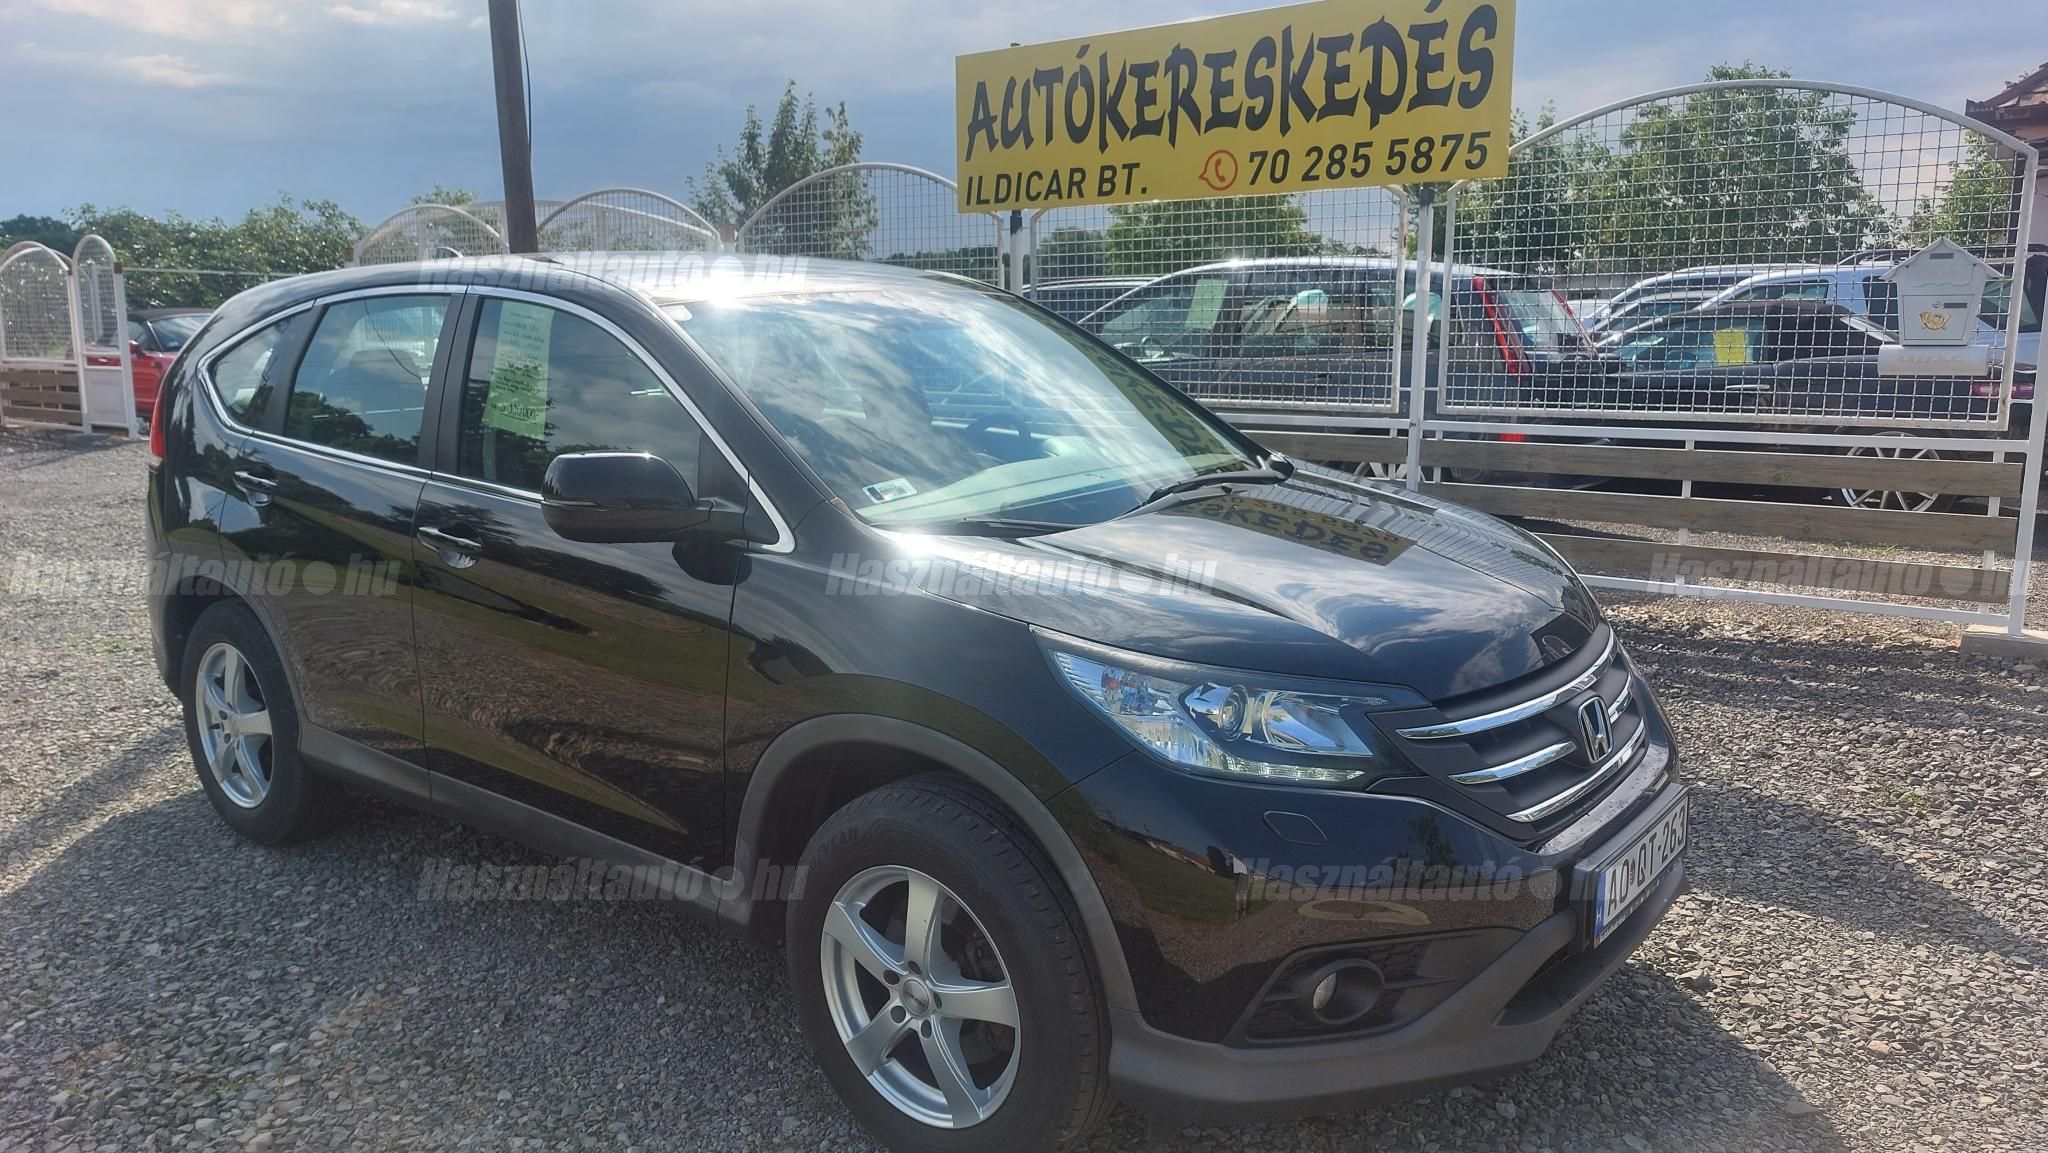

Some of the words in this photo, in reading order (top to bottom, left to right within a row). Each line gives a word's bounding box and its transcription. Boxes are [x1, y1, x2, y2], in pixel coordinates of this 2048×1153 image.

[965, 0, 1499, 162] AUTÓKERESKEDÉS
[966, 165, 1086, 207] ILDICAR
[1099, 161, 1148, 198] BT.
[1248, 148, 1291, 187] 70
[1301, 140, 1372, 183] 285
[1385, 130, 1492, 175] 5875
